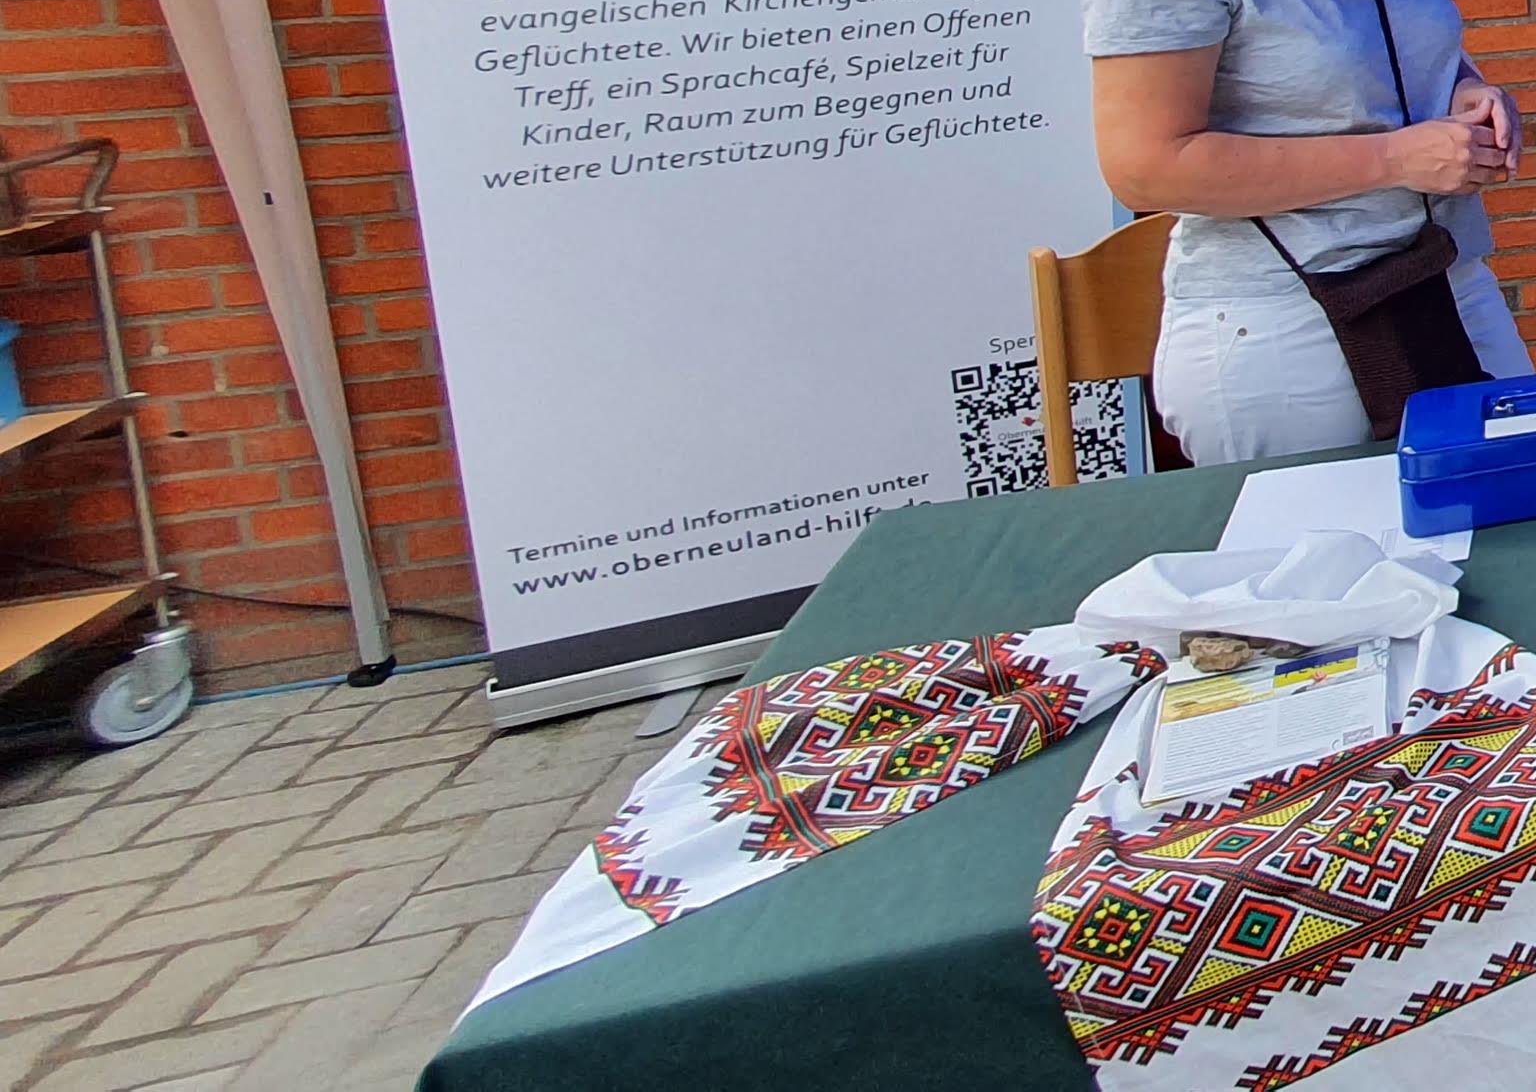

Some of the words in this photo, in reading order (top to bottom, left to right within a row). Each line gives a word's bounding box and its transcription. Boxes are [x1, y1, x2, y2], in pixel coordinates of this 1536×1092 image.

[474, 41, 672, 76] Geflüchtete.
[681, 31, 734, 55] Wir
[742, 26, 831, 50] bieten
[840, 18, 916, 41] einen
[923, 8, 1031, 38] Offenen
[514, 79, 595, 111] Treff,
[607, 77, 652, 99] ein
[660, 57, 837, 99] Sprachcafé,
[845, 48, 964, 81] Spielzeit
[967, 43, 1010, 71] für
[522, 117, 632, 146] Kinder,
[644, 109, 733, 134] Raum
[742, 102, 804, 125] zum
[813, 86, 953, 119] Begegnen
[961, 75, 1012, 101] und
[482, 162, 602, 189] weitere
[610, 136, 829, 176] Unterstützung
[833, 127, 879, 158] für
[885, 112, 1051, 148] Geflüchtete.
[507, 532, 619, 565] Termine
[626, 519, 675, 543] und
[682, 484, 861, 533] Informationen
[866, 472, 931, 496] unter
